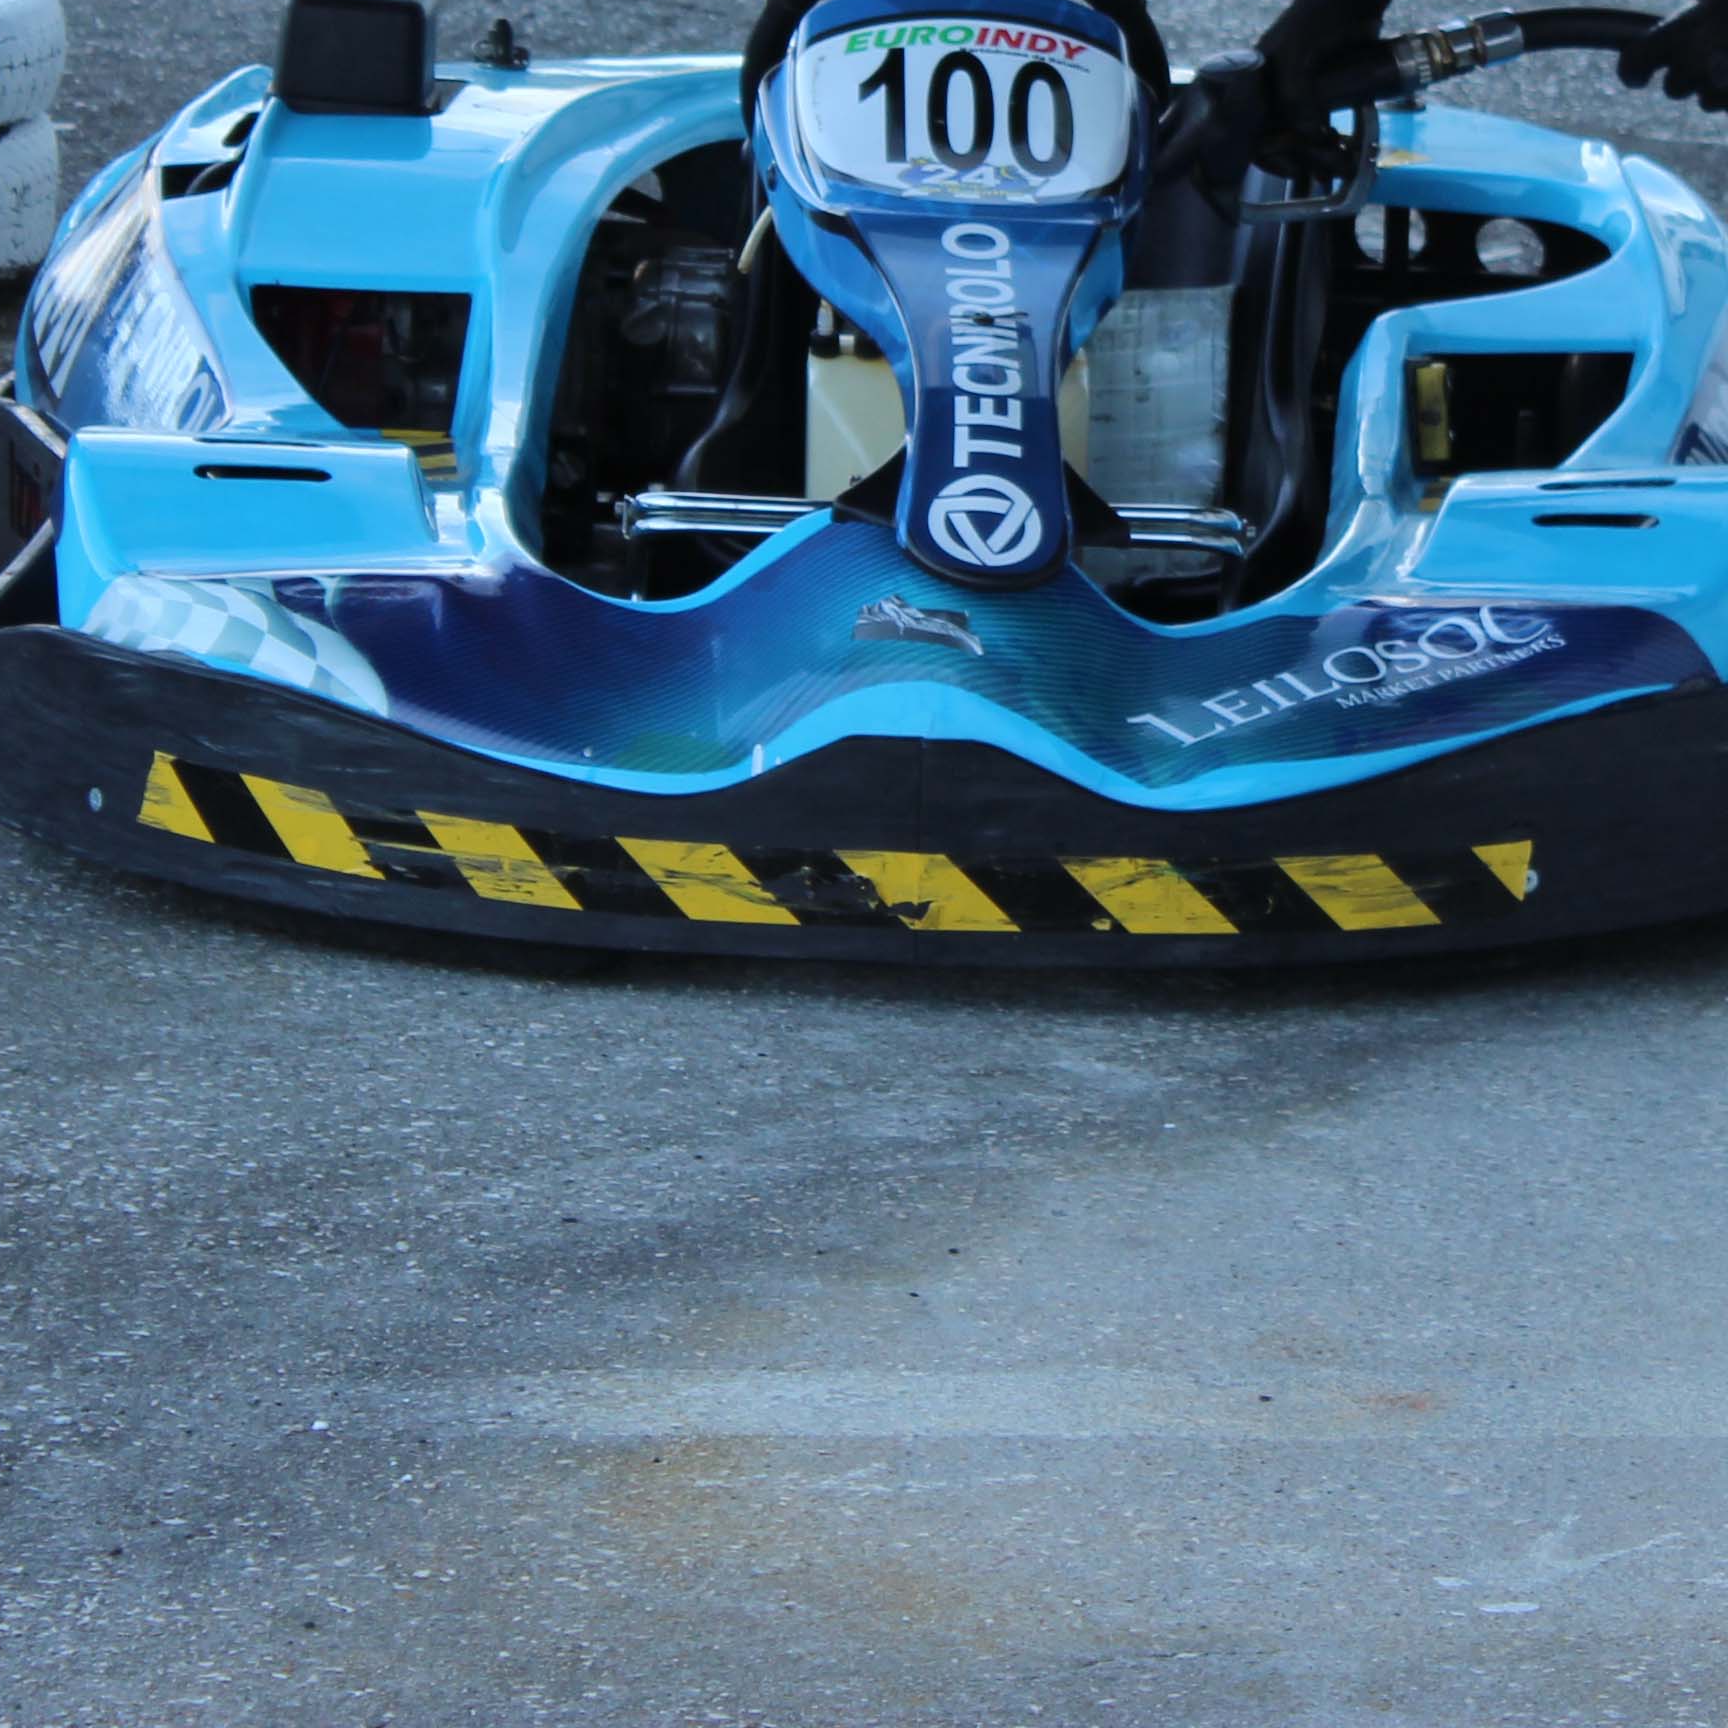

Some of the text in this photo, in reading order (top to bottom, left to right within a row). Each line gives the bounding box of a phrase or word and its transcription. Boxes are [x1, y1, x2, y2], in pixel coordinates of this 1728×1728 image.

[858, 47, 1074, 178] 100
[941, 222, 1023, 468] TECNIROLO
[1335, 632, 1567, 710] MARKET PARTNERS
